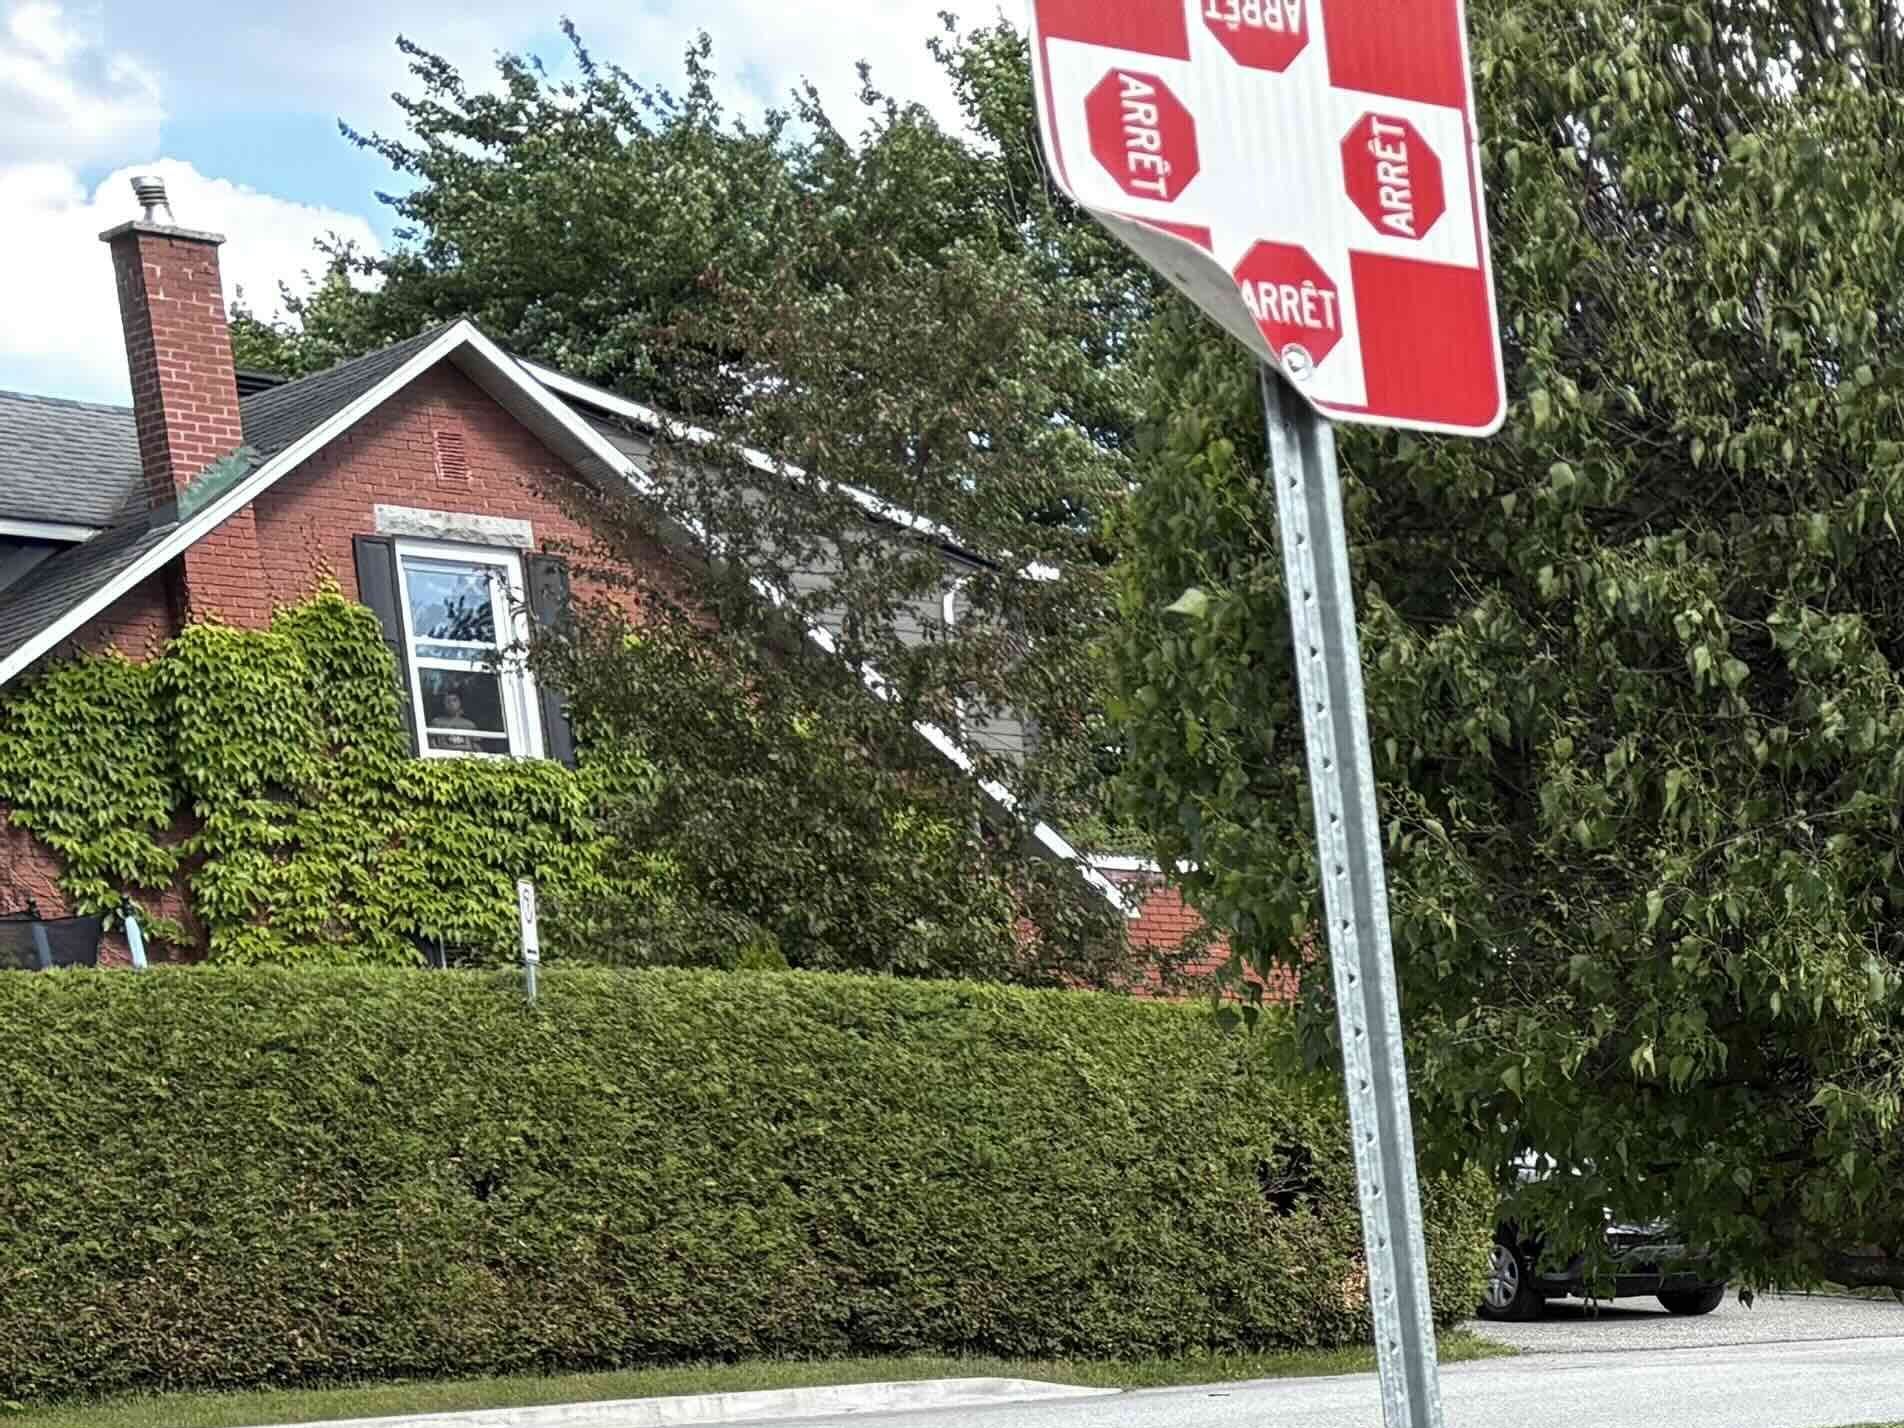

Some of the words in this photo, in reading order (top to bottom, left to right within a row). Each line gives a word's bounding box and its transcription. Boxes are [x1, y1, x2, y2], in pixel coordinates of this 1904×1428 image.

[1118, 71, 1172, 198] ARRÊT
[1367, 115, 1417, 238] ARRÊT
[1241, 278, 1336, 331] ARRÊT
